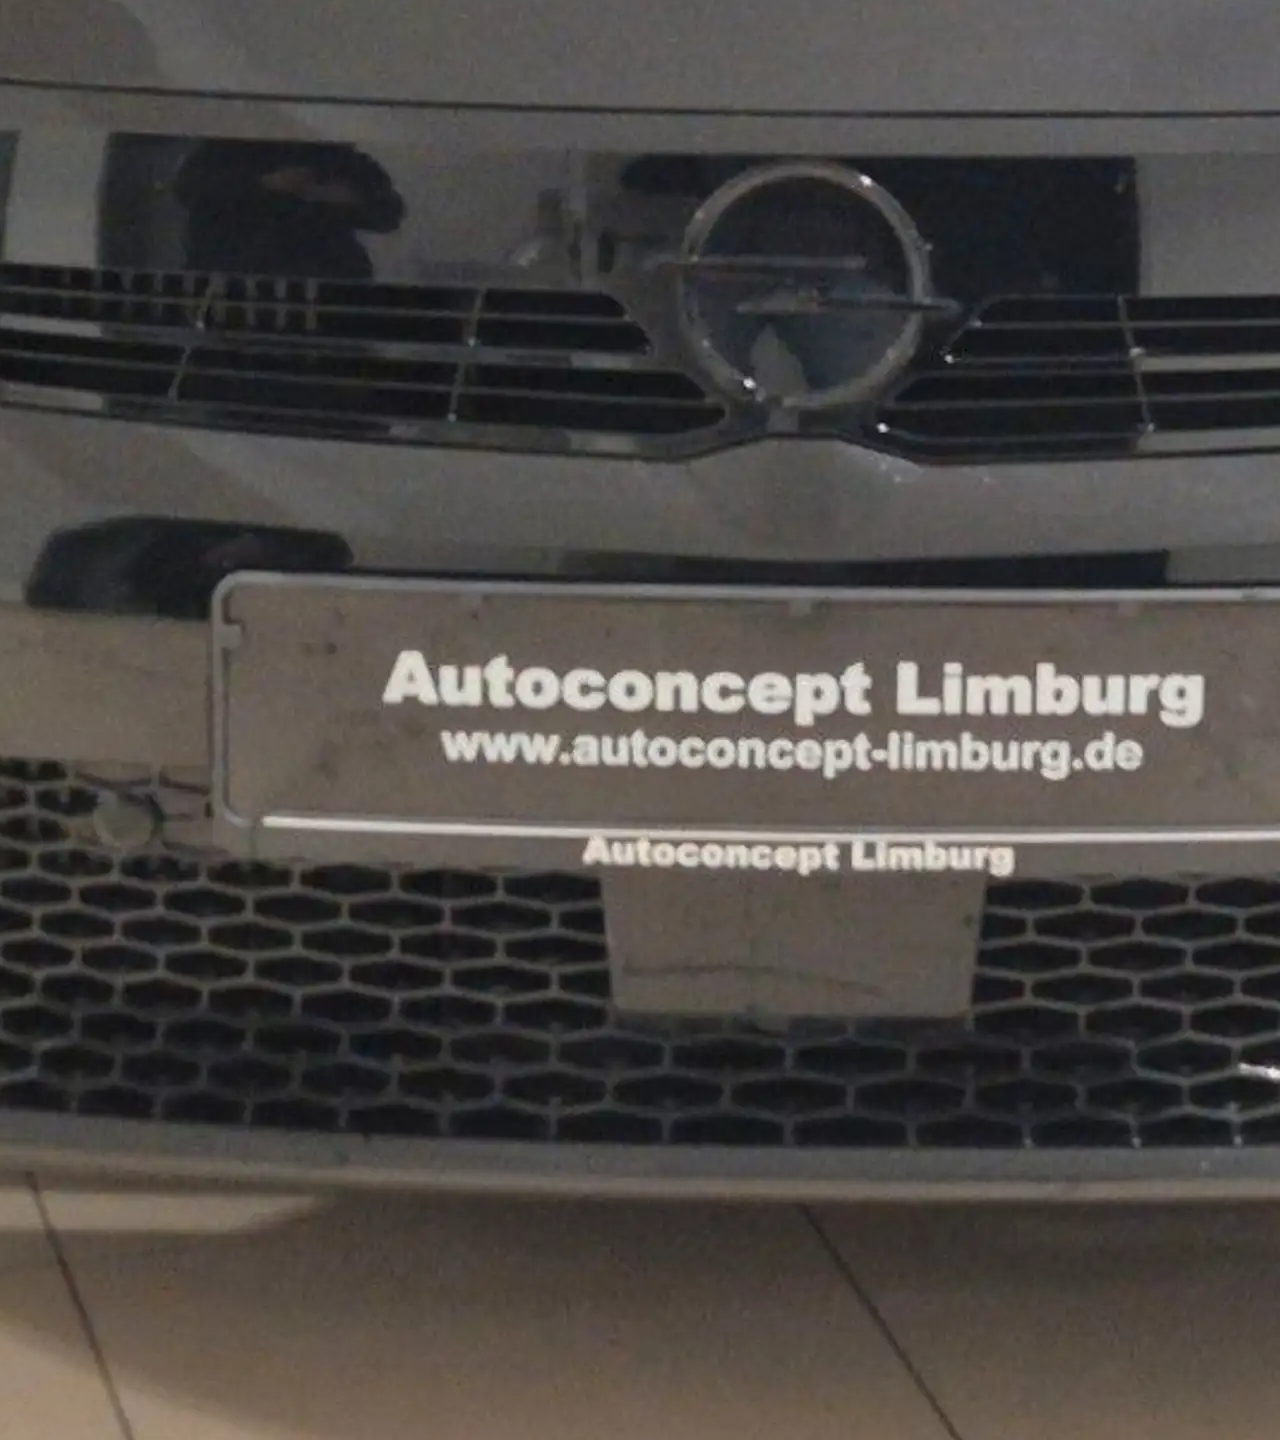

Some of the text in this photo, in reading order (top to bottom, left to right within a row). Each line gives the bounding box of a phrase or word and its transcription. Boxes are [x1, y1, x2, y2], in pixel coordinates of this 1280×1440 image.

[382, 649, 1206, 728] Autoconcept Limburg
[440, 728, 1145, 781] www.autoconcept-limburg.de
[581, 834, 1017, 878] Autoconcept Limburg
